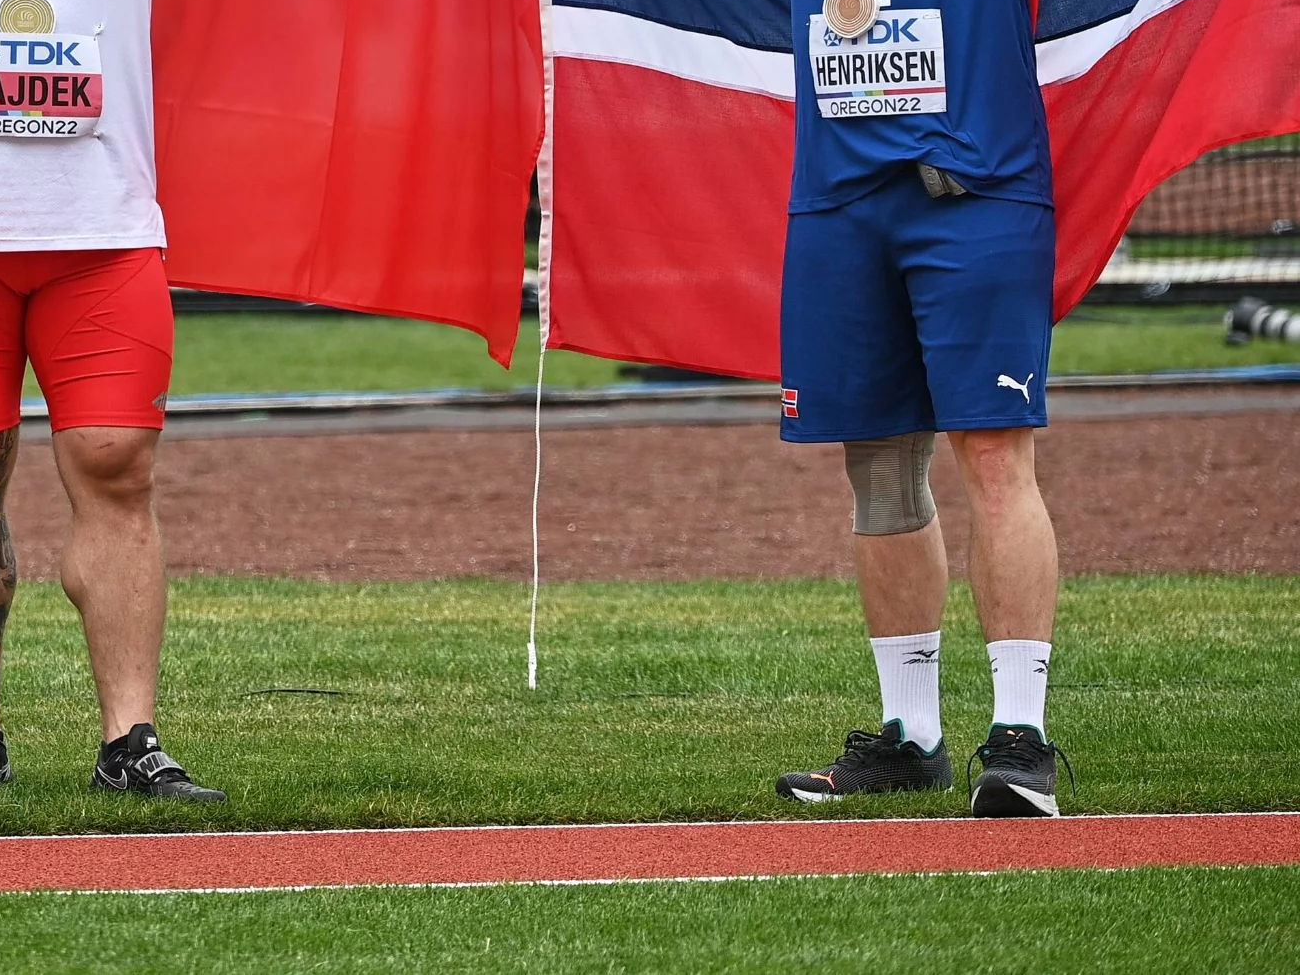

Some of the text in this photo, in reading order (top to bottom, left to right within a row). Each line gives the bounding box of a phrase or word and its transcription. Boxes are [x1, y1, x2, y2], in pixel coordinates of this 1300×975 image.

[851, 17, 920, 45] DK
[0, 40, 82, 66] TDK
[815, 50, 937, 87] HENRIKSEN
[830, 97, 922, 116] OREGON22
